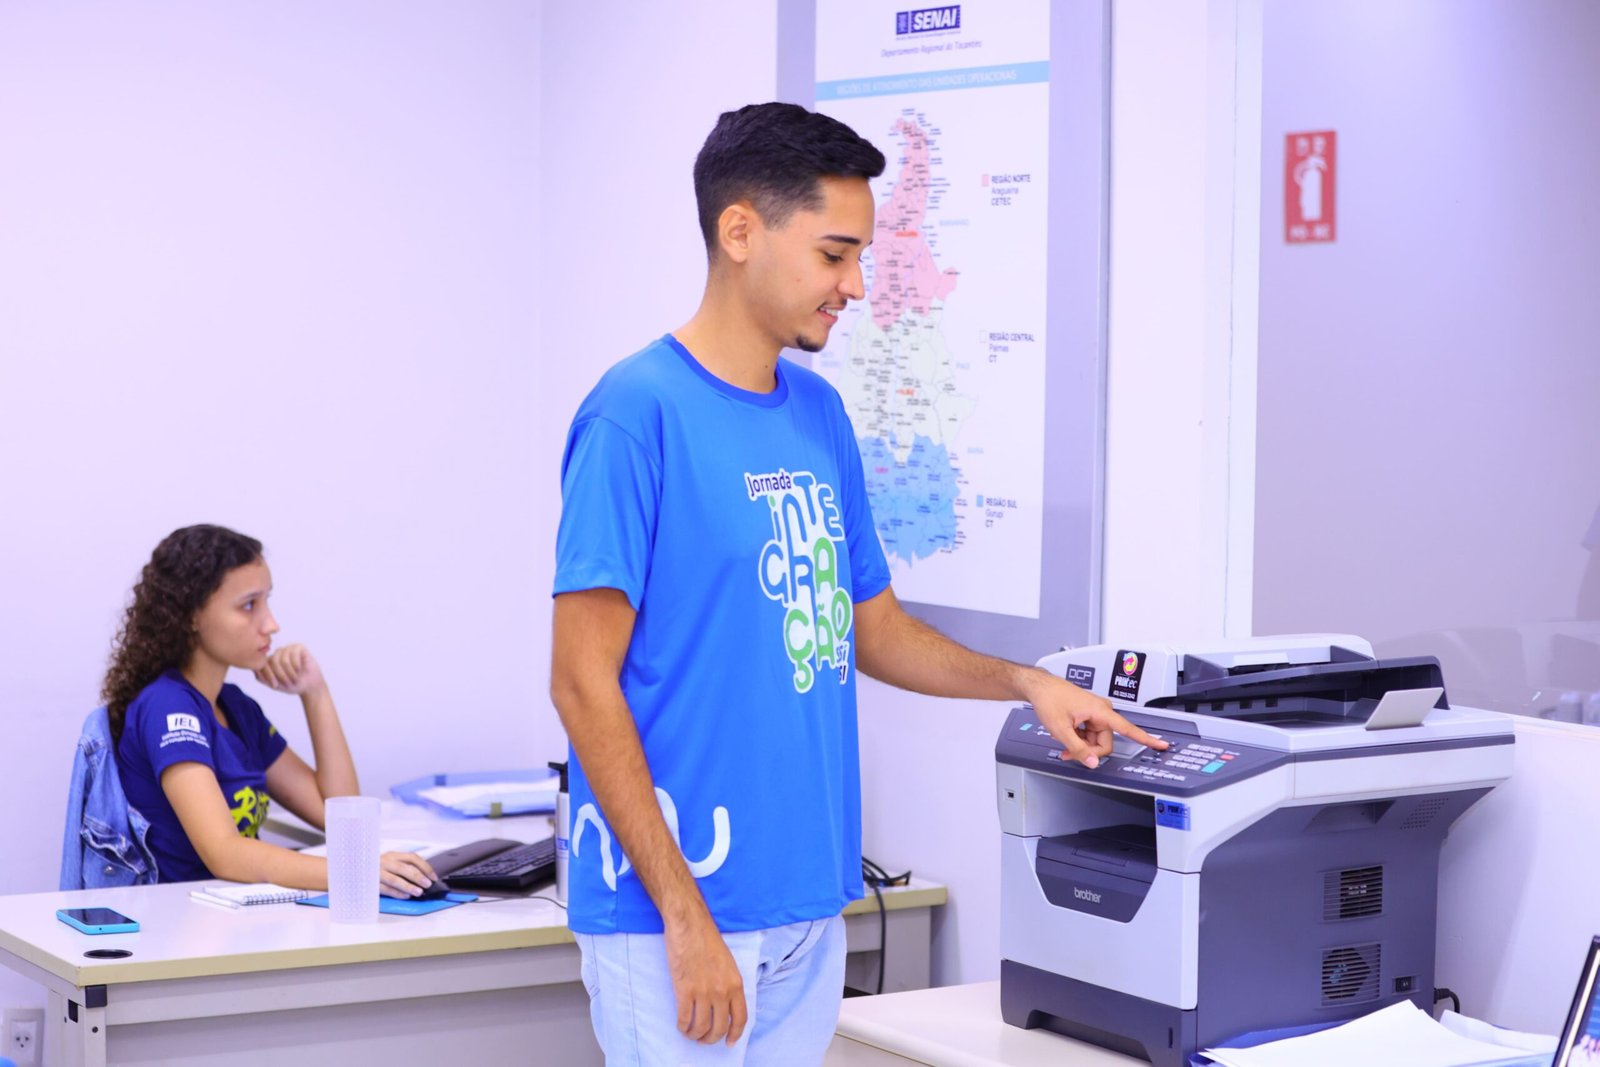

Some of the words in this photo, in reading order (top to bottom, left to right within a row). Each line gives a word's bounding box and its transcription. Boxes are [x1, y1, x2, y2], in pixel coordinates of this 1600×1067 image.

[913, 8, 957, 30] SENAI
[991, 173, 1011, 184] REGIÃO
[1012, 173, 1031, 183] NORTE
[991, 197, 1011, 206] CETEC
[989, 331, 1009, 342] REGIÃO
[1010, 333, 1035, 342] CENTRAL
[746, 471, 792, 497] Jornada
[986, 497, 1006, 508] REGIÃO
[1007, 499, 1018, 509] SUL
[1068, 668, 1092, 681] DCP
[174, 717, 195, 729] IEL
[1073, 886, 1102, 904] brother
